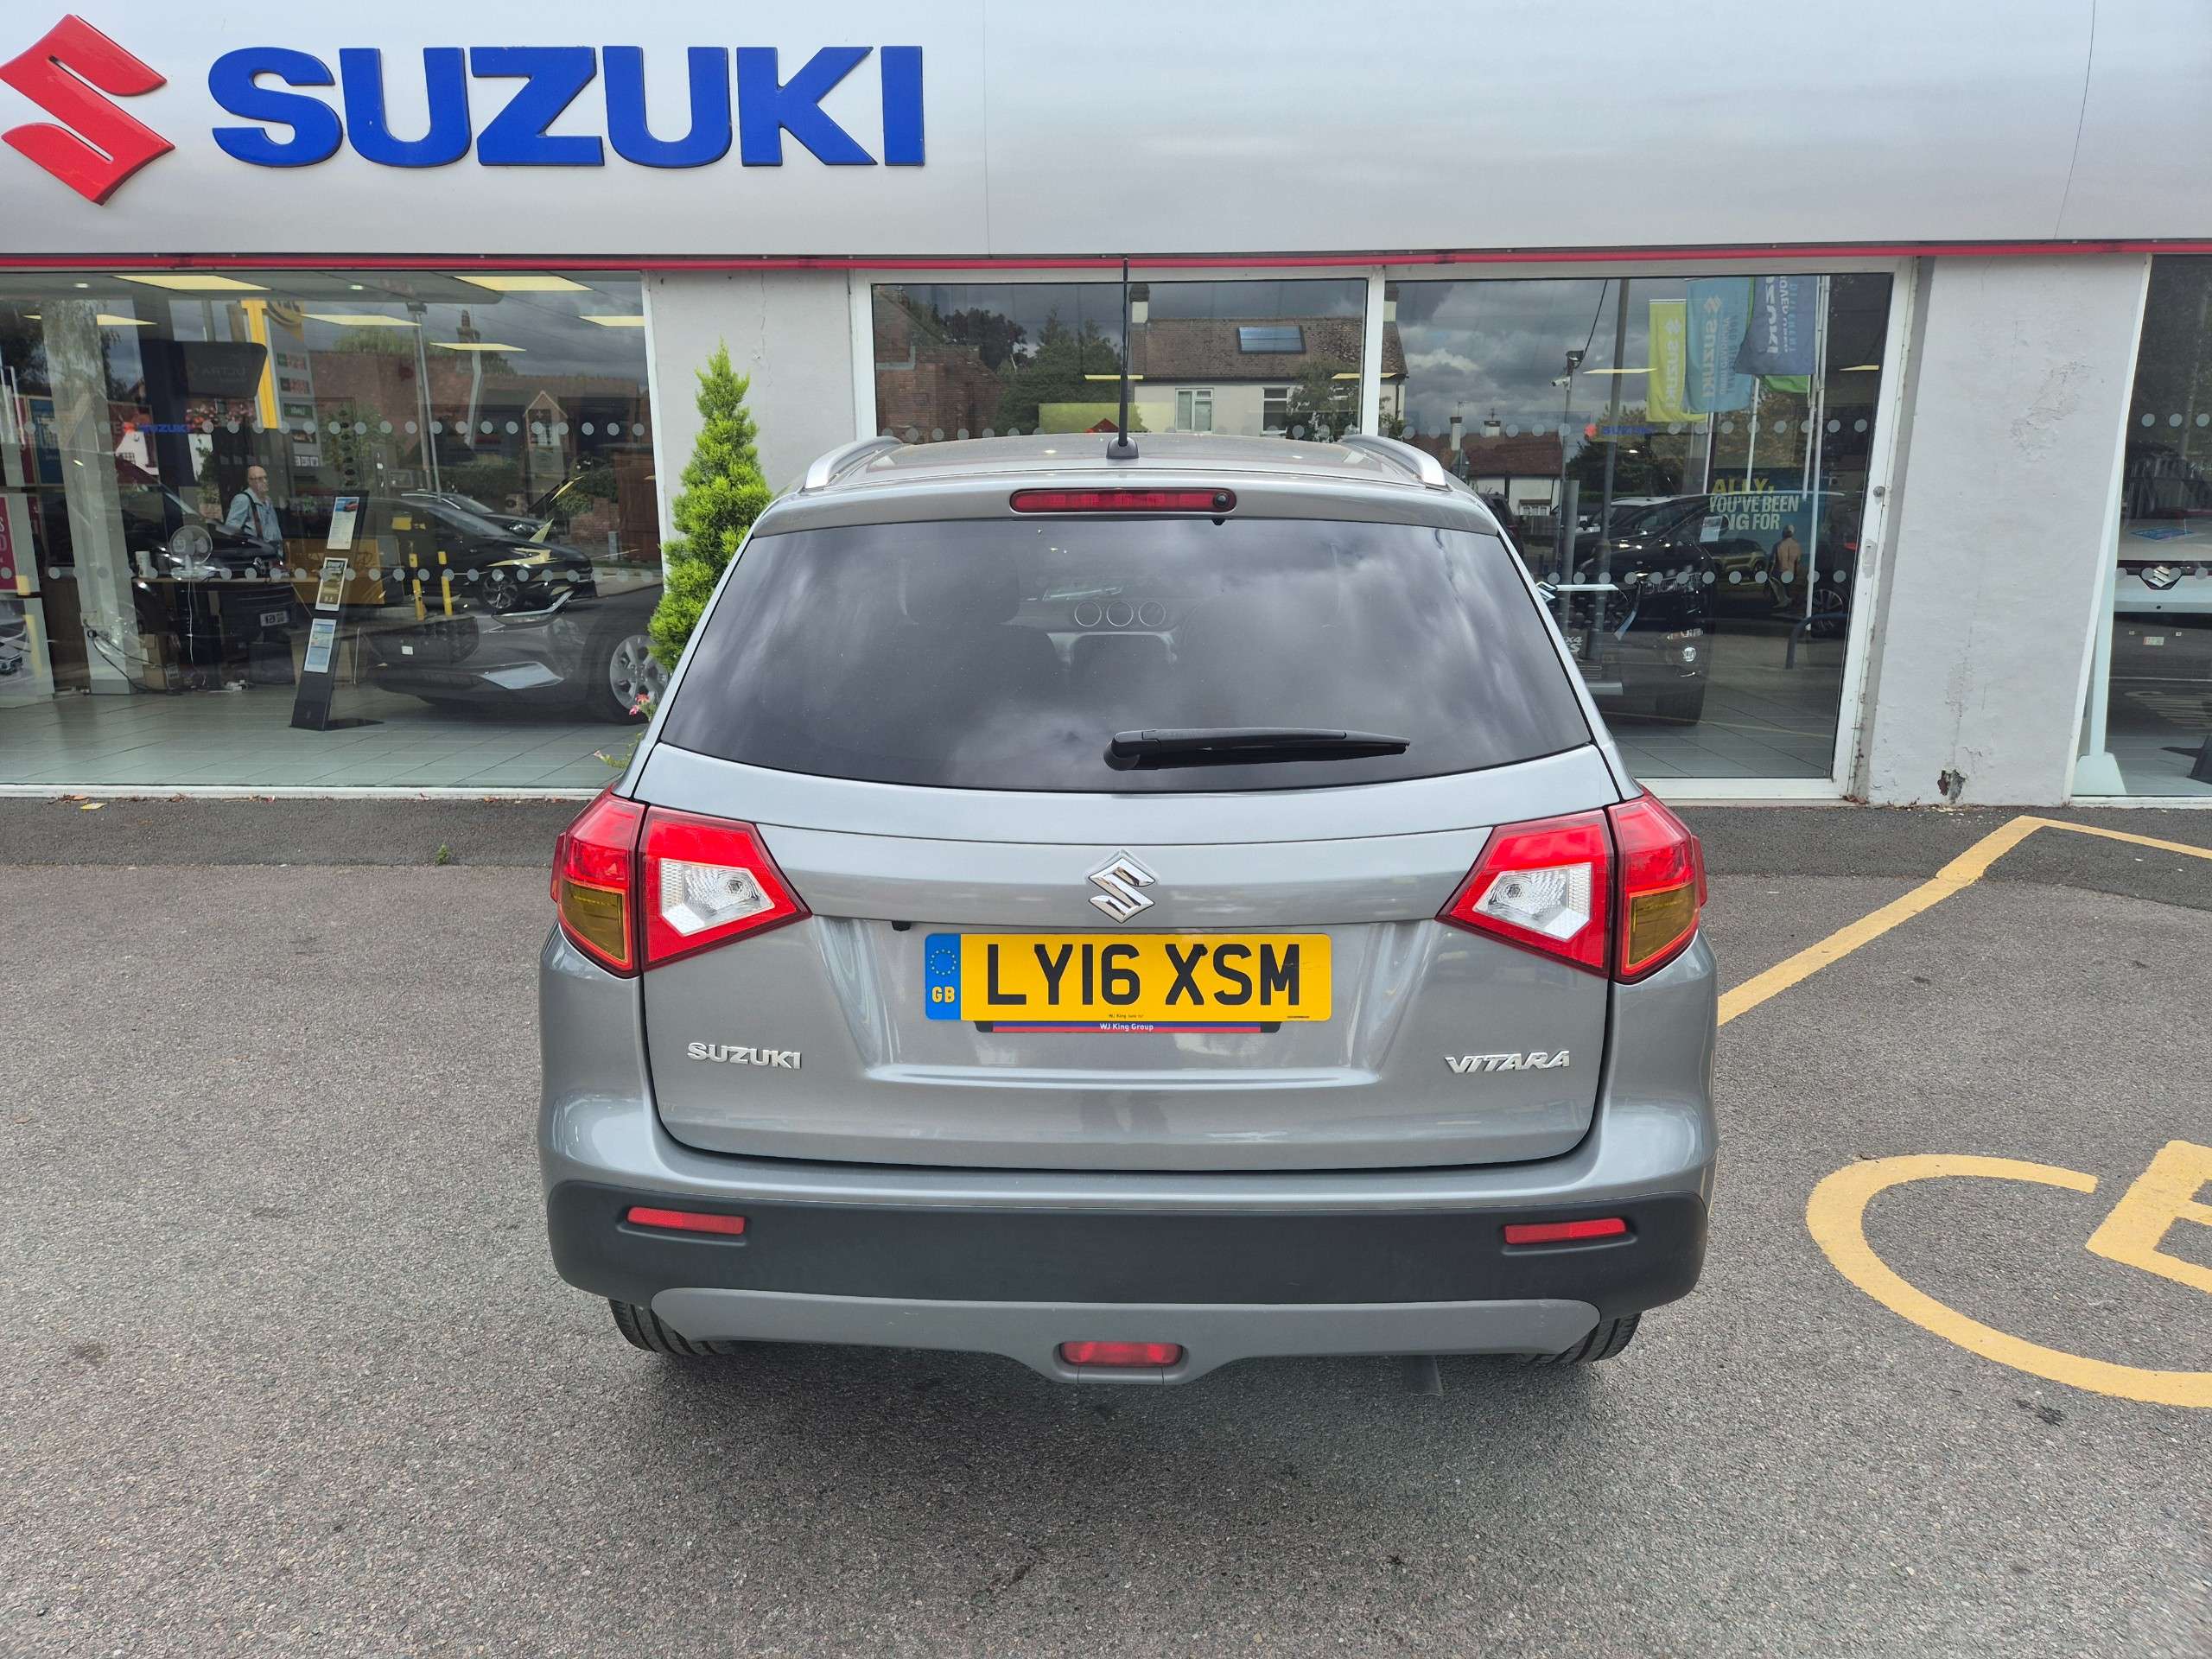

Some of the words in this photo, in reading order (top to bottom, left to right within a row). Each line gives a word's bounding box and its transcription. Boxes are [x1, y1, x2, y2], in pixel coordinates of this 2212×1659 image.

[208, 46, 925, 168] SUZUKI
[1709, 495, 1759, 513] YOU'VE
[1762, 495, 1800, 512] BEEN
[1752, 513, 1781, 530] FOR
[987, 944, 1141, 1006] LY16
[1165, 944, 1300, 1006] XSM
[932, 986, 955, 1002] GB
[1113, 1023, 1129, 1032] King
[1131, 1023, 1154, 1032] Group
[687, 1042, 802, 1070] SUZUKI
[1445, 1050, 1570, 1073] VITARA
